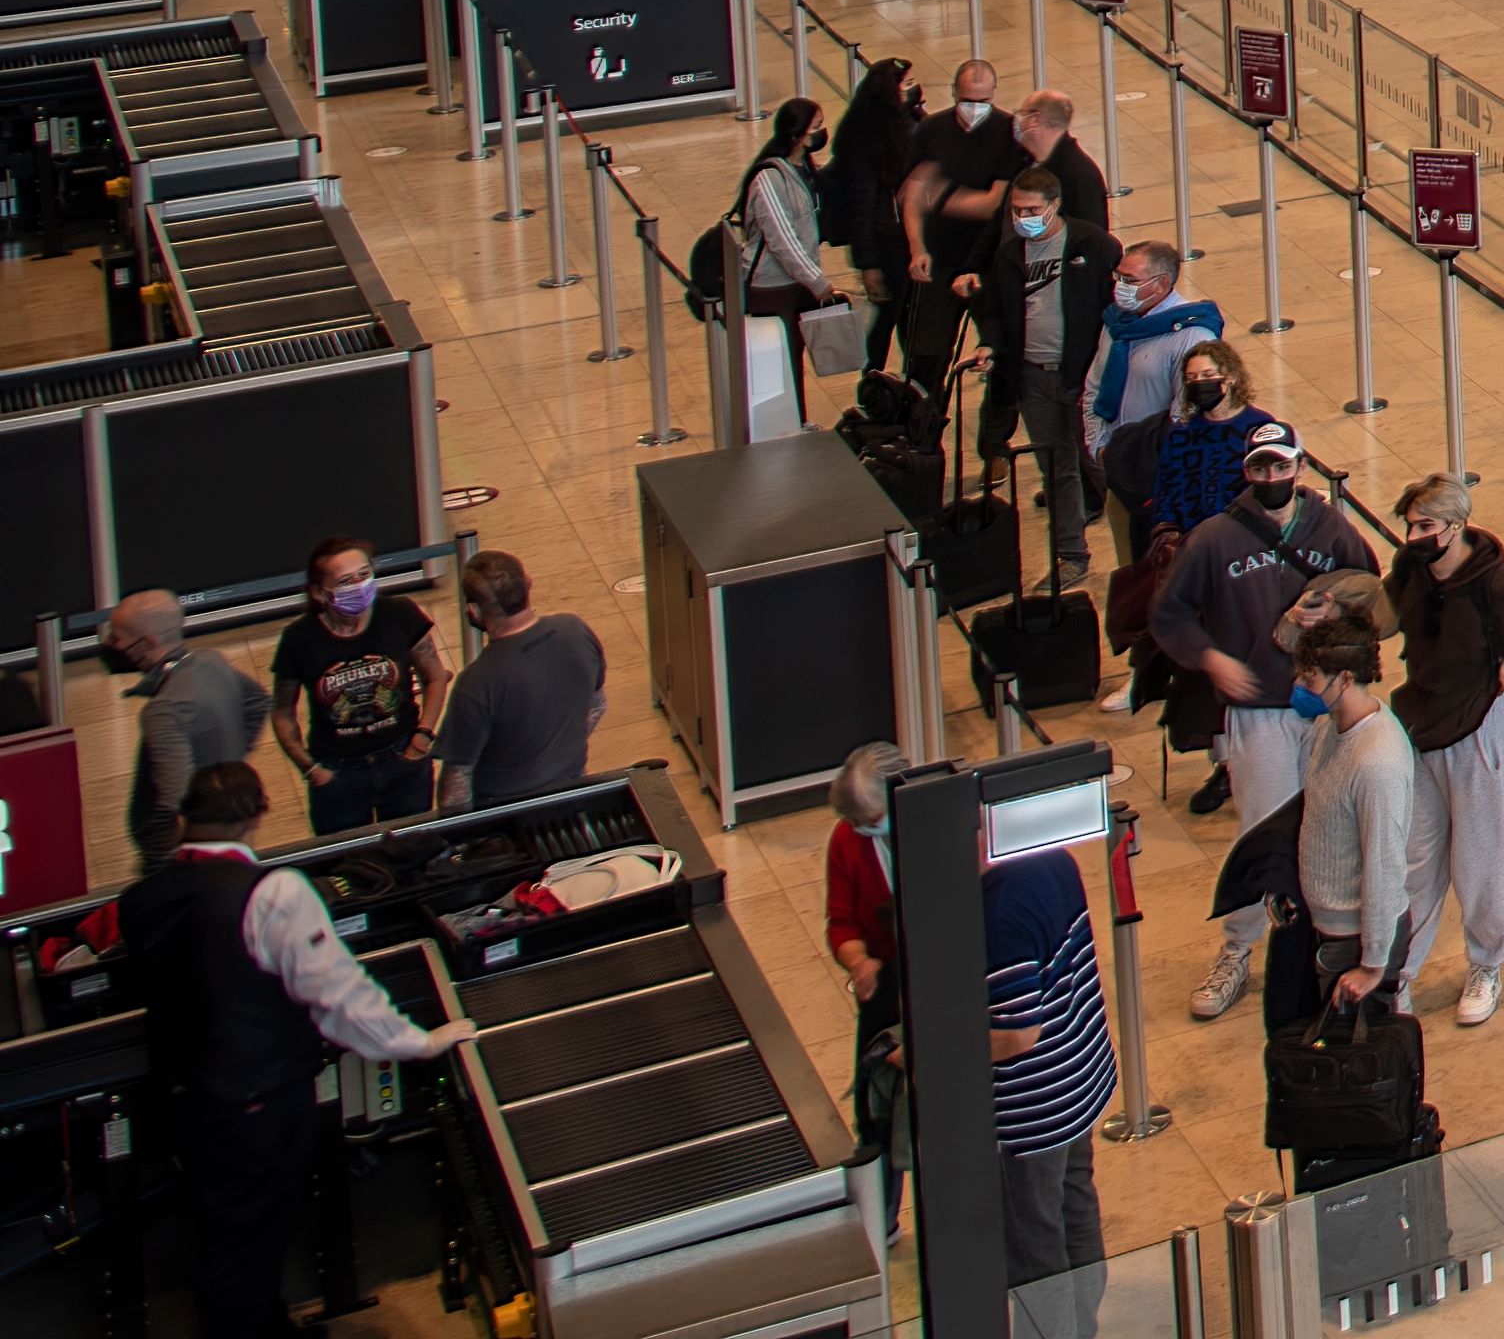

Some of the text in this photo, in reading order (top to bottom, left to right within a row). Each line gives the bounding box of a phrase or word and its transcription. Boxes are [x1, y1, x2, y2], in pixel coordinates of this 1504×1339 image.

[573, 11, 638, 31] Security
[672, 73, 695, 85] BER
[1227, 548, 1335, 577] CANDA
[326, 661, 390, 691] PHUKET
